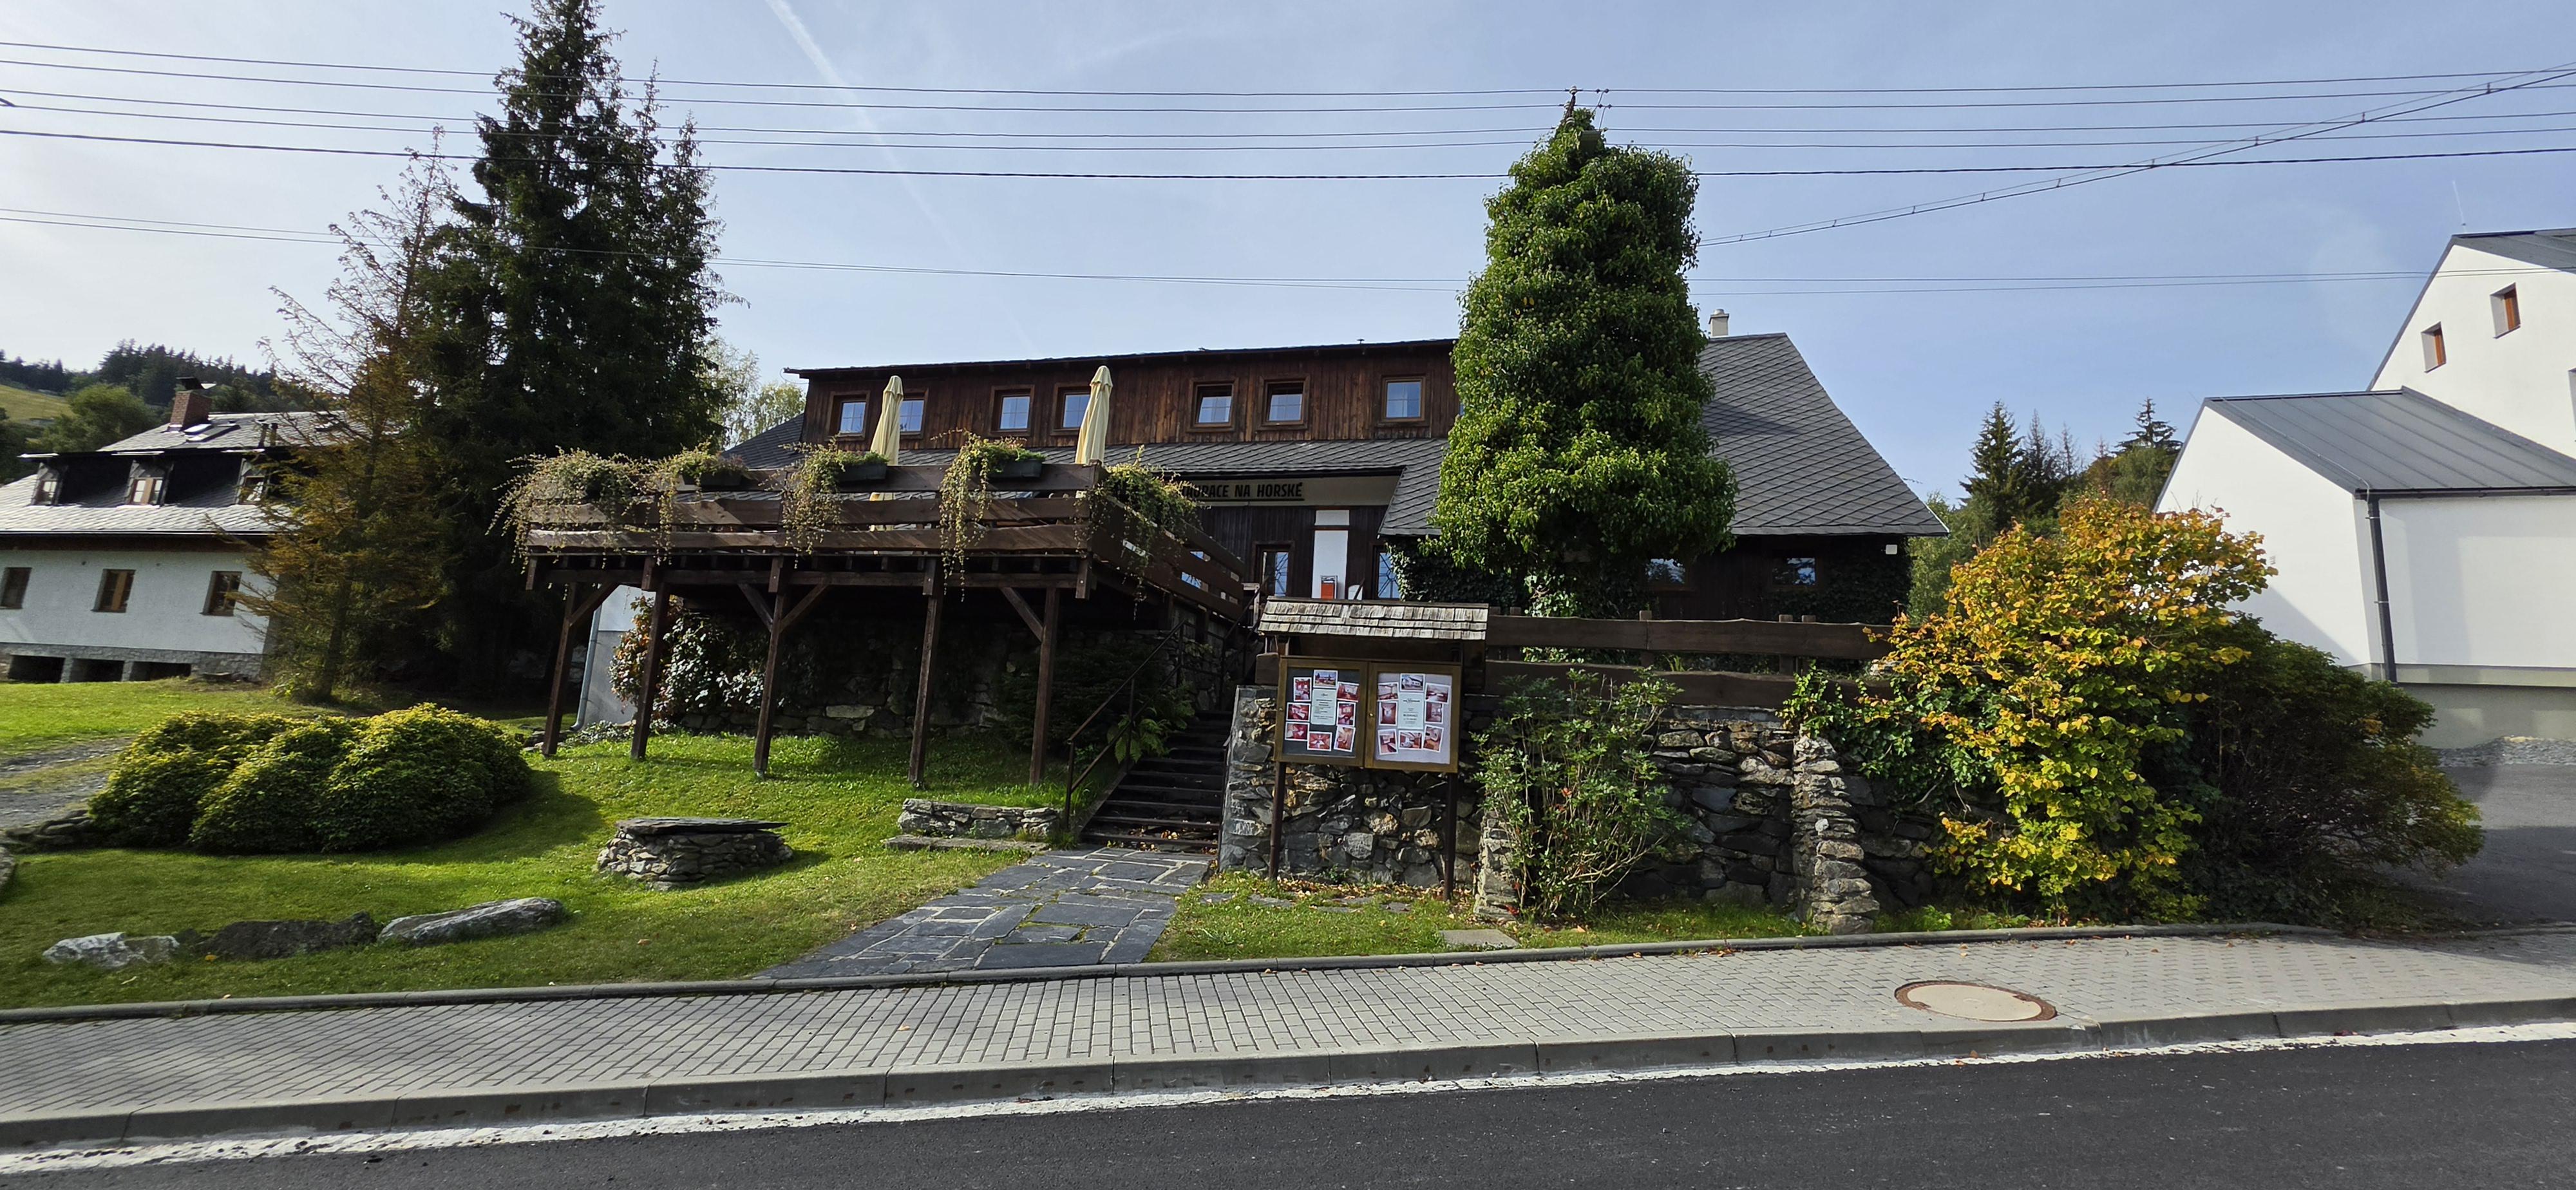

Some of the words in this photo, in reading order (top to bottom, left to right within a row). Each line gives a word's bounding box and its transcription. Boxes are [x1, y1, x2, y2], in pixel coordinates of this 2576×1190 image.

[1182, 484, 1229, 498] TAURACE
[1235, 484, 1250, 498] NA
[1257, 482, 1303, 497] HORSKÉ
